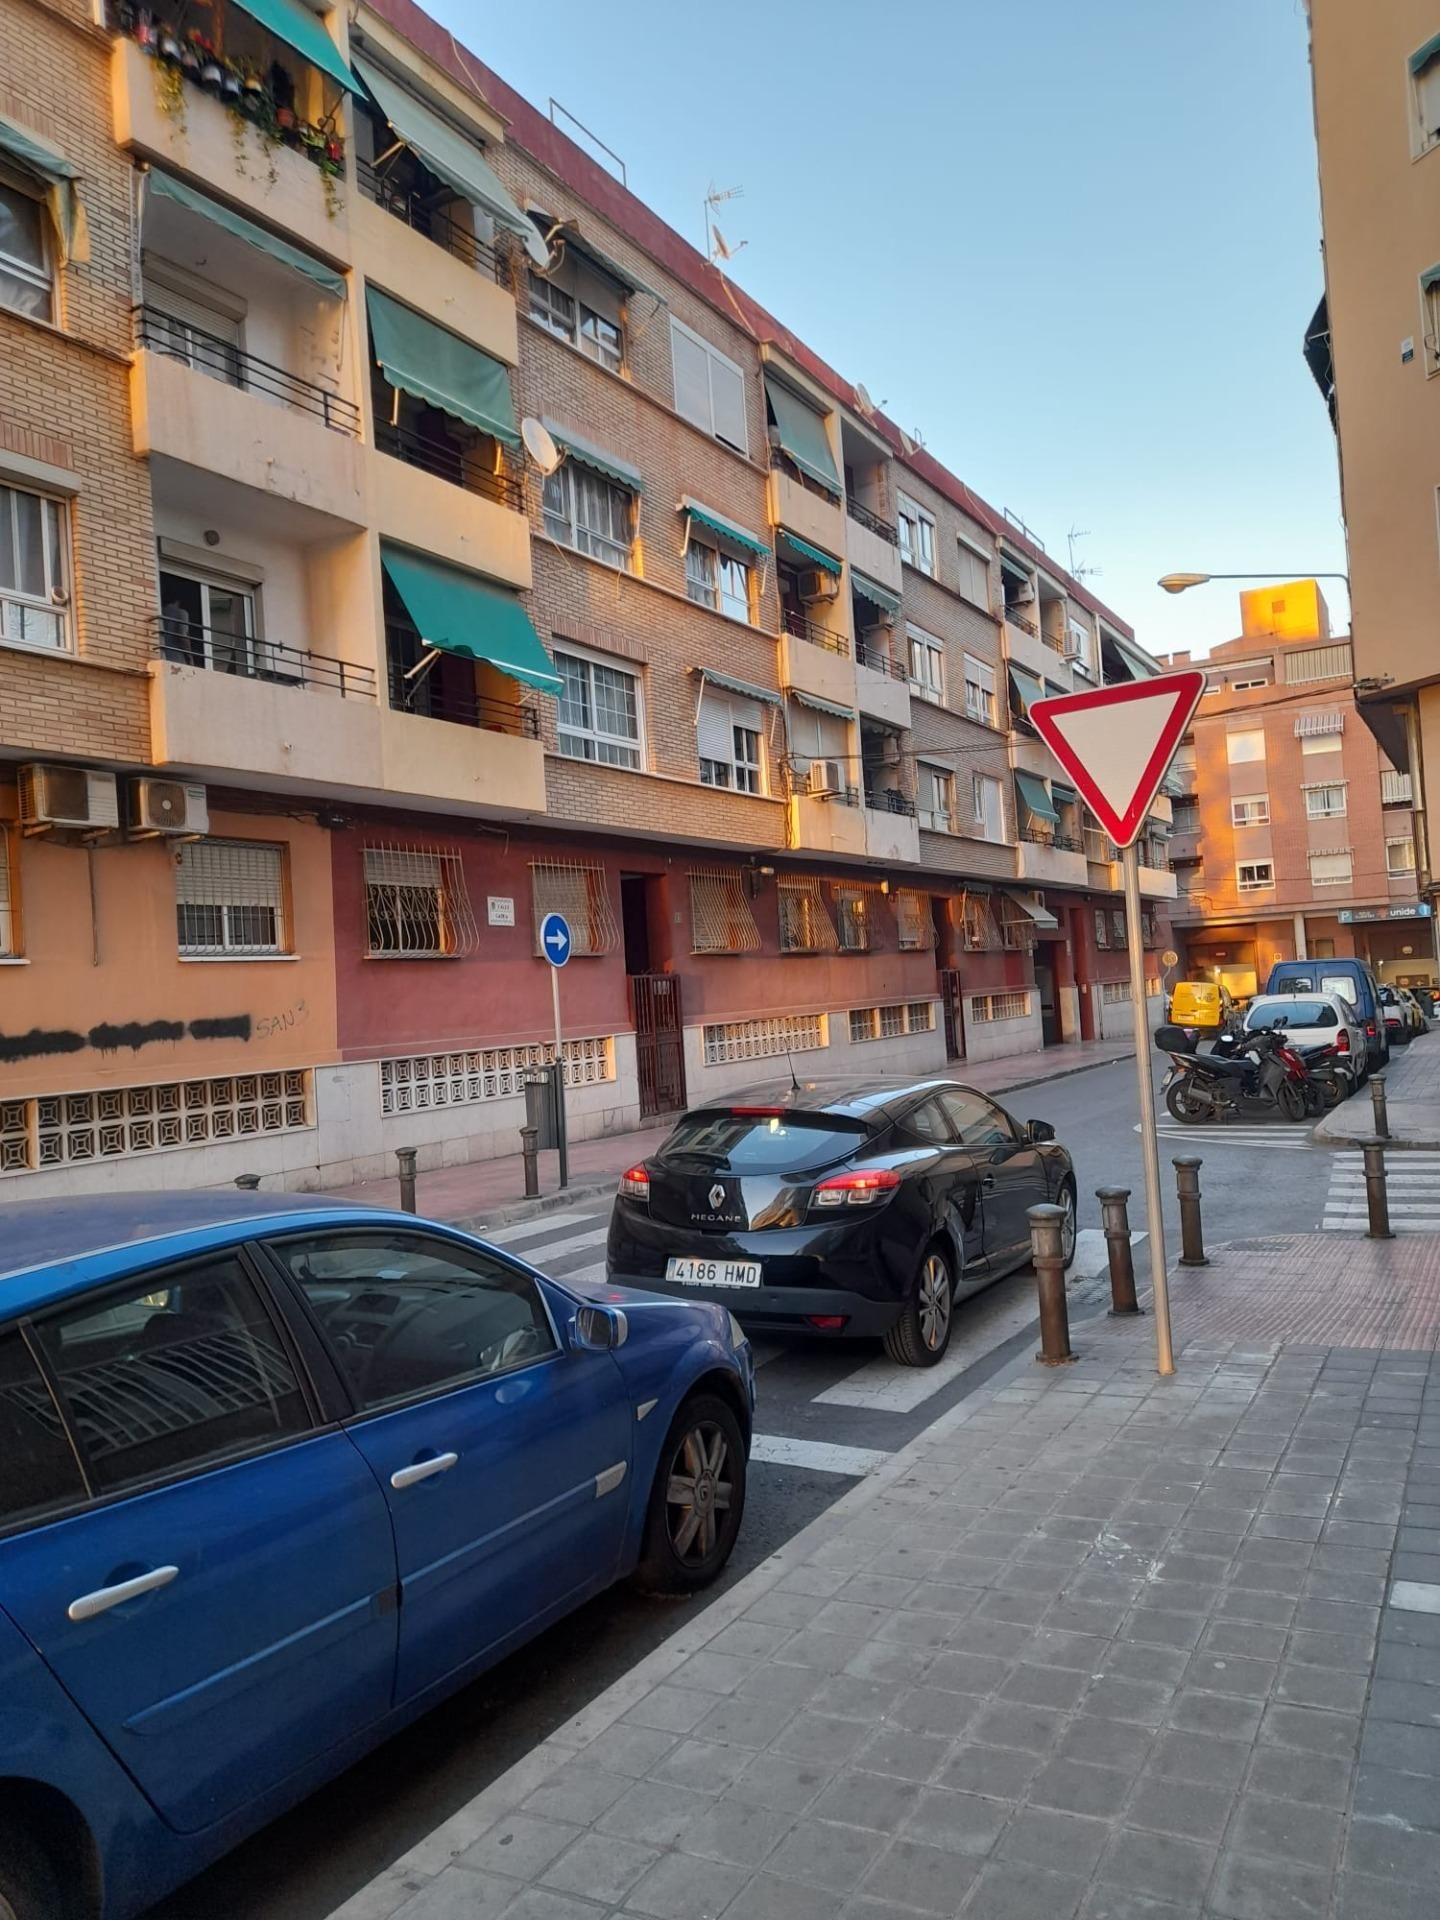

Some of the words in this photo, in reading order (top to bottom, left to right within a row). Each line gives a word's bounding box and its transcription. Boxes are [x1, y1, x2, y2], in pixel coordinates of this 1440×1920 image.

[1390, 907, 1416, 917] unide
[676, 1262, 716, 1281] 4186
[724, 1265, 757, 1285] HMD
